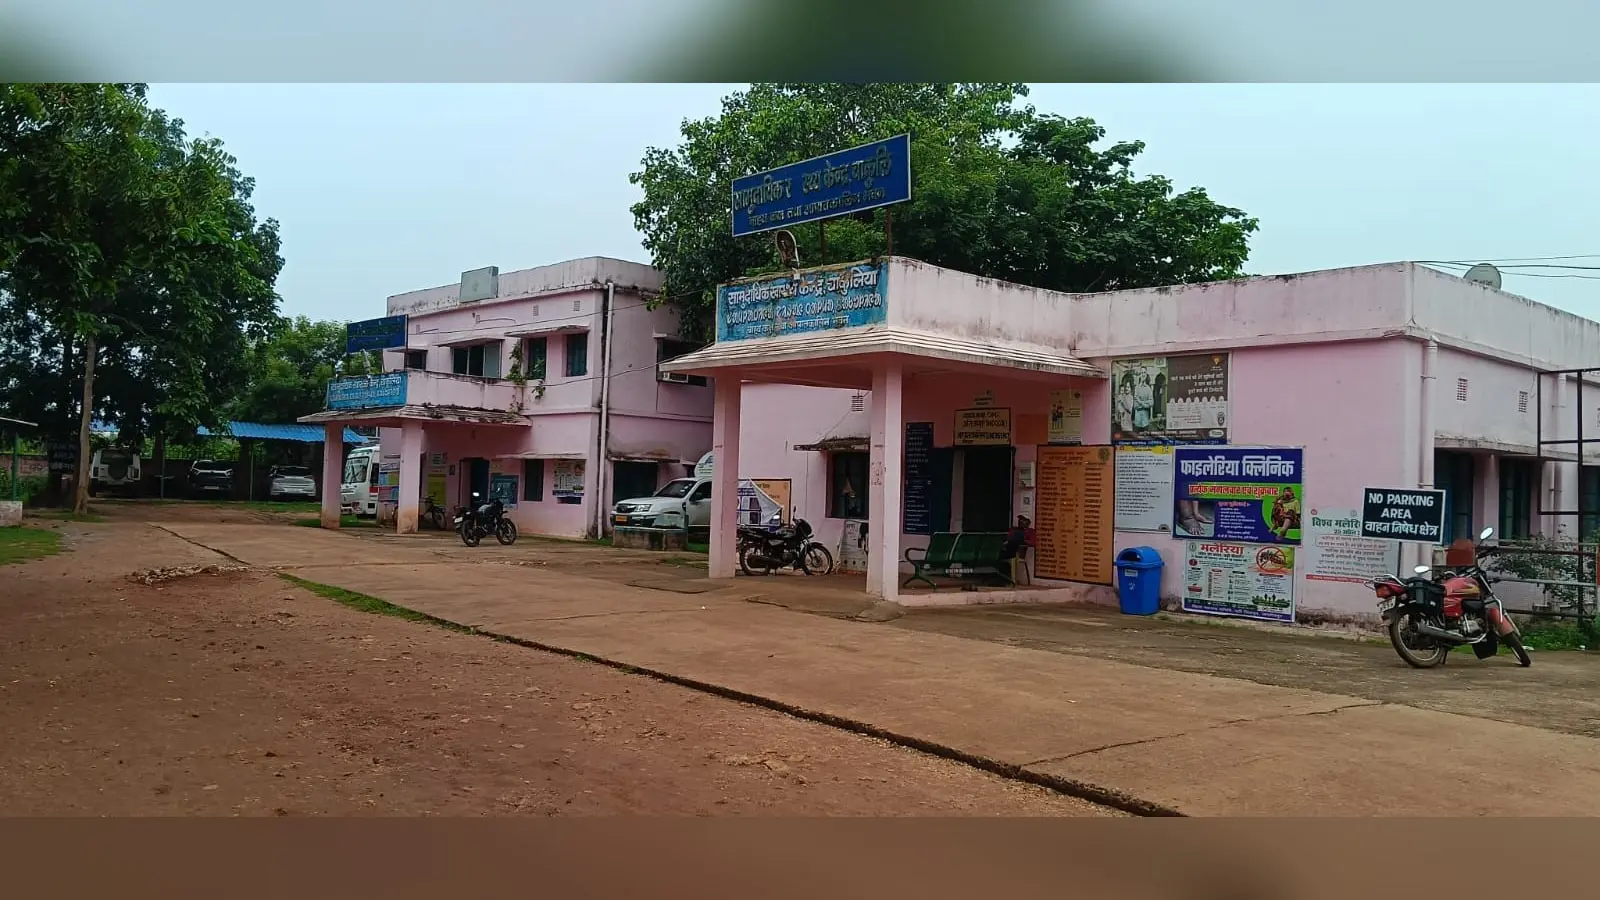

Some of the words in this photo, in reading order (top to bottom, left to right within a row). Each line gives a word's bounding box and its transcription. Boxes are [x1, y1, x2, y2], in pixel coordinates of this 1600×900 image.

[1180, 456, 1240, 477] फाइलेरिया
[1241, 456, 1294, 477] क्लिनिक
[1368, 493, 1383, 504] NO
[1387, 493, 1434, 507] PARKING
[1381, 508, 1412, 519] AREA
[1364, 521, 1390, 533] वाहन
[1391, 520, 1419, 536] निषेध
[1419, 521, 1439, 536] क्षेत्र
